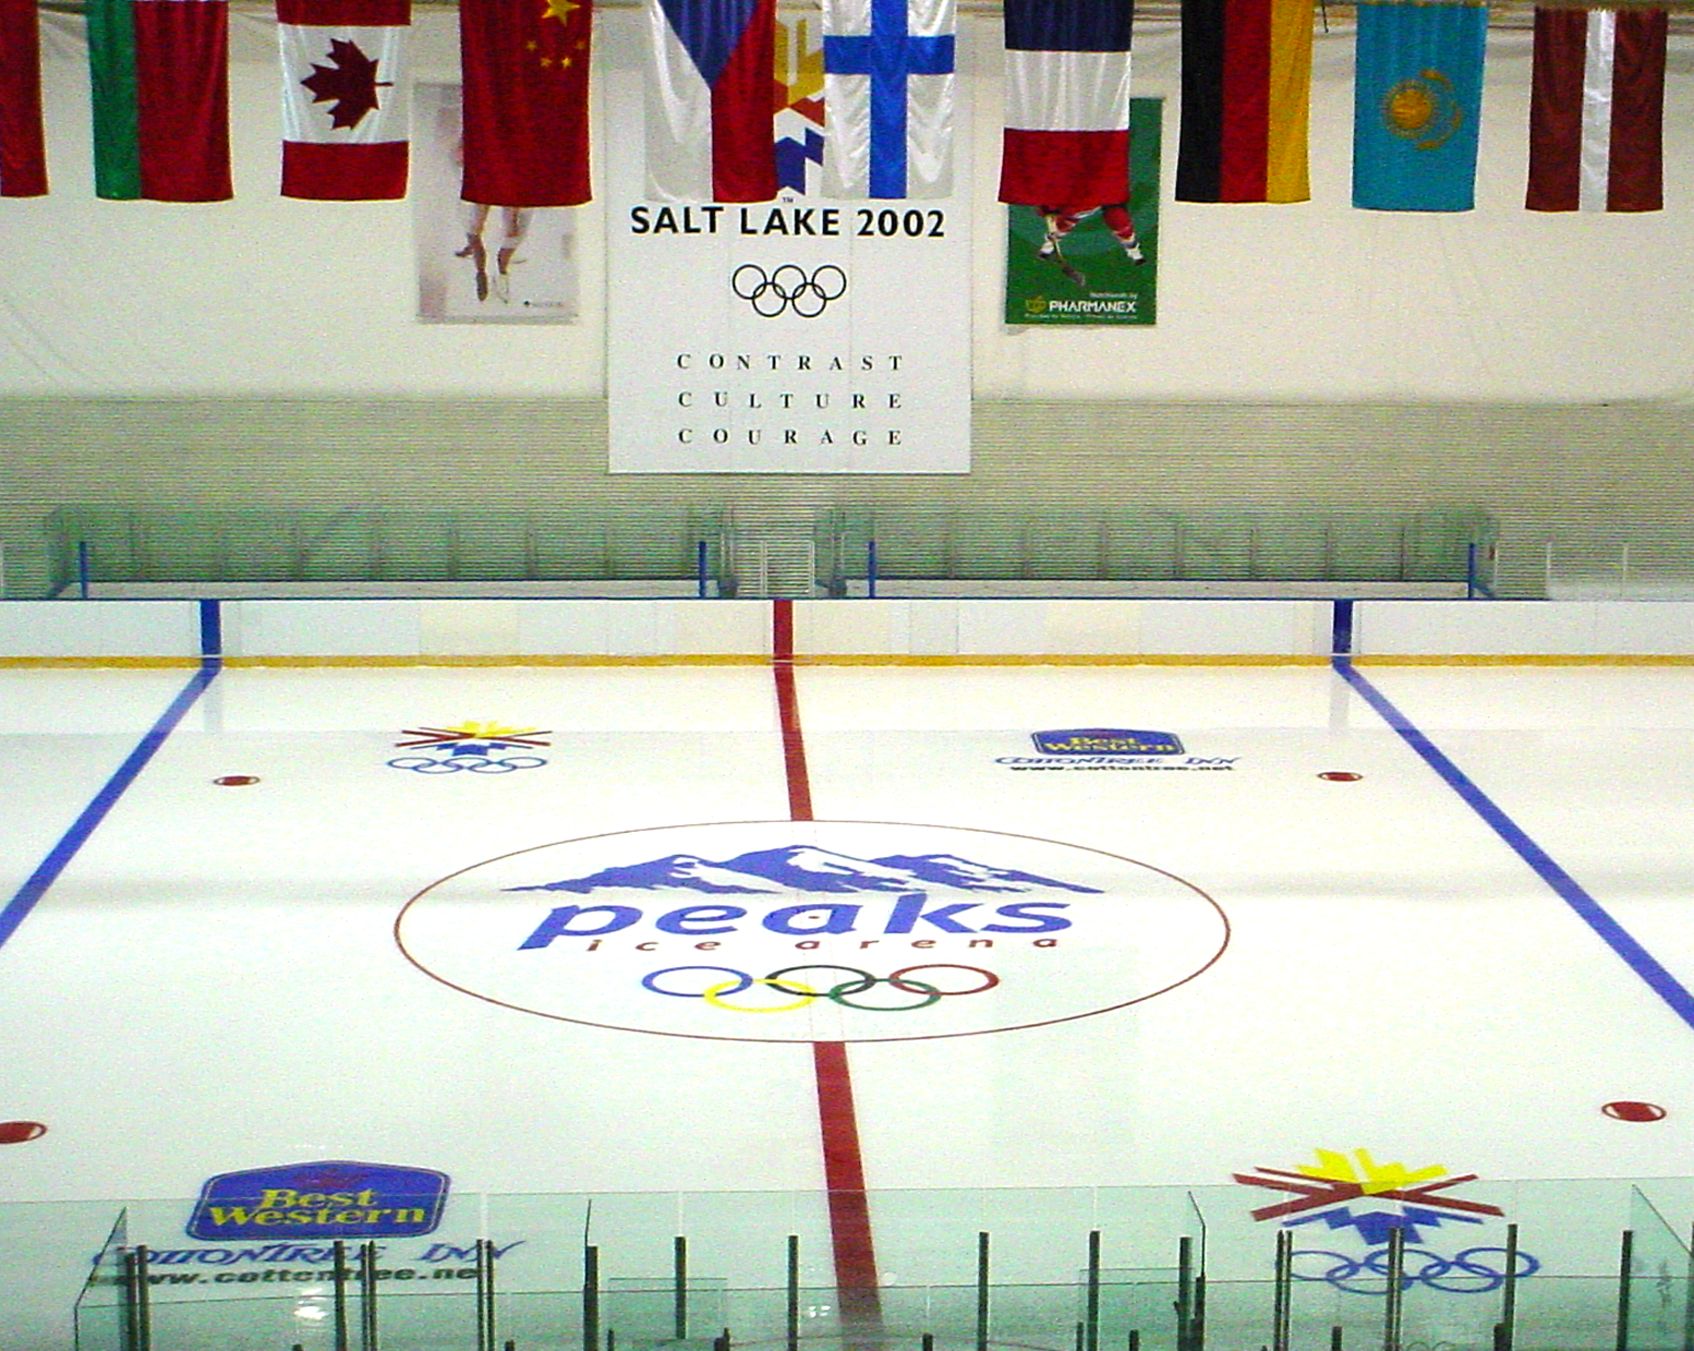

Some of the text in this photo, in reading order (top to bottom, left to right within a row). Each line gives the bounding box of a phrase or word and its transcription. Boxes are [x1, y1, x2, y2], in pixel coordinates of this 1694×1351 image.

[630, 206, 945, 238] SALT LAKE 2002
[1049, 300, 1137, 313] PHARMANEX
[677, 354, 903, 371] CONTRAST
[677, 391, 902, 410] CULTURE
[678, 428, 902, 446] COURAGE
[1043, 743, 1177, 751] Western
[1069, 736, 1137, 746] Best
[517, 893, 1073, 951] peaks
[586, 936, 1058, 952] ice arena
[260, 1187, 378, 1209] Best
[209, 1206, 426, 1227] Western
